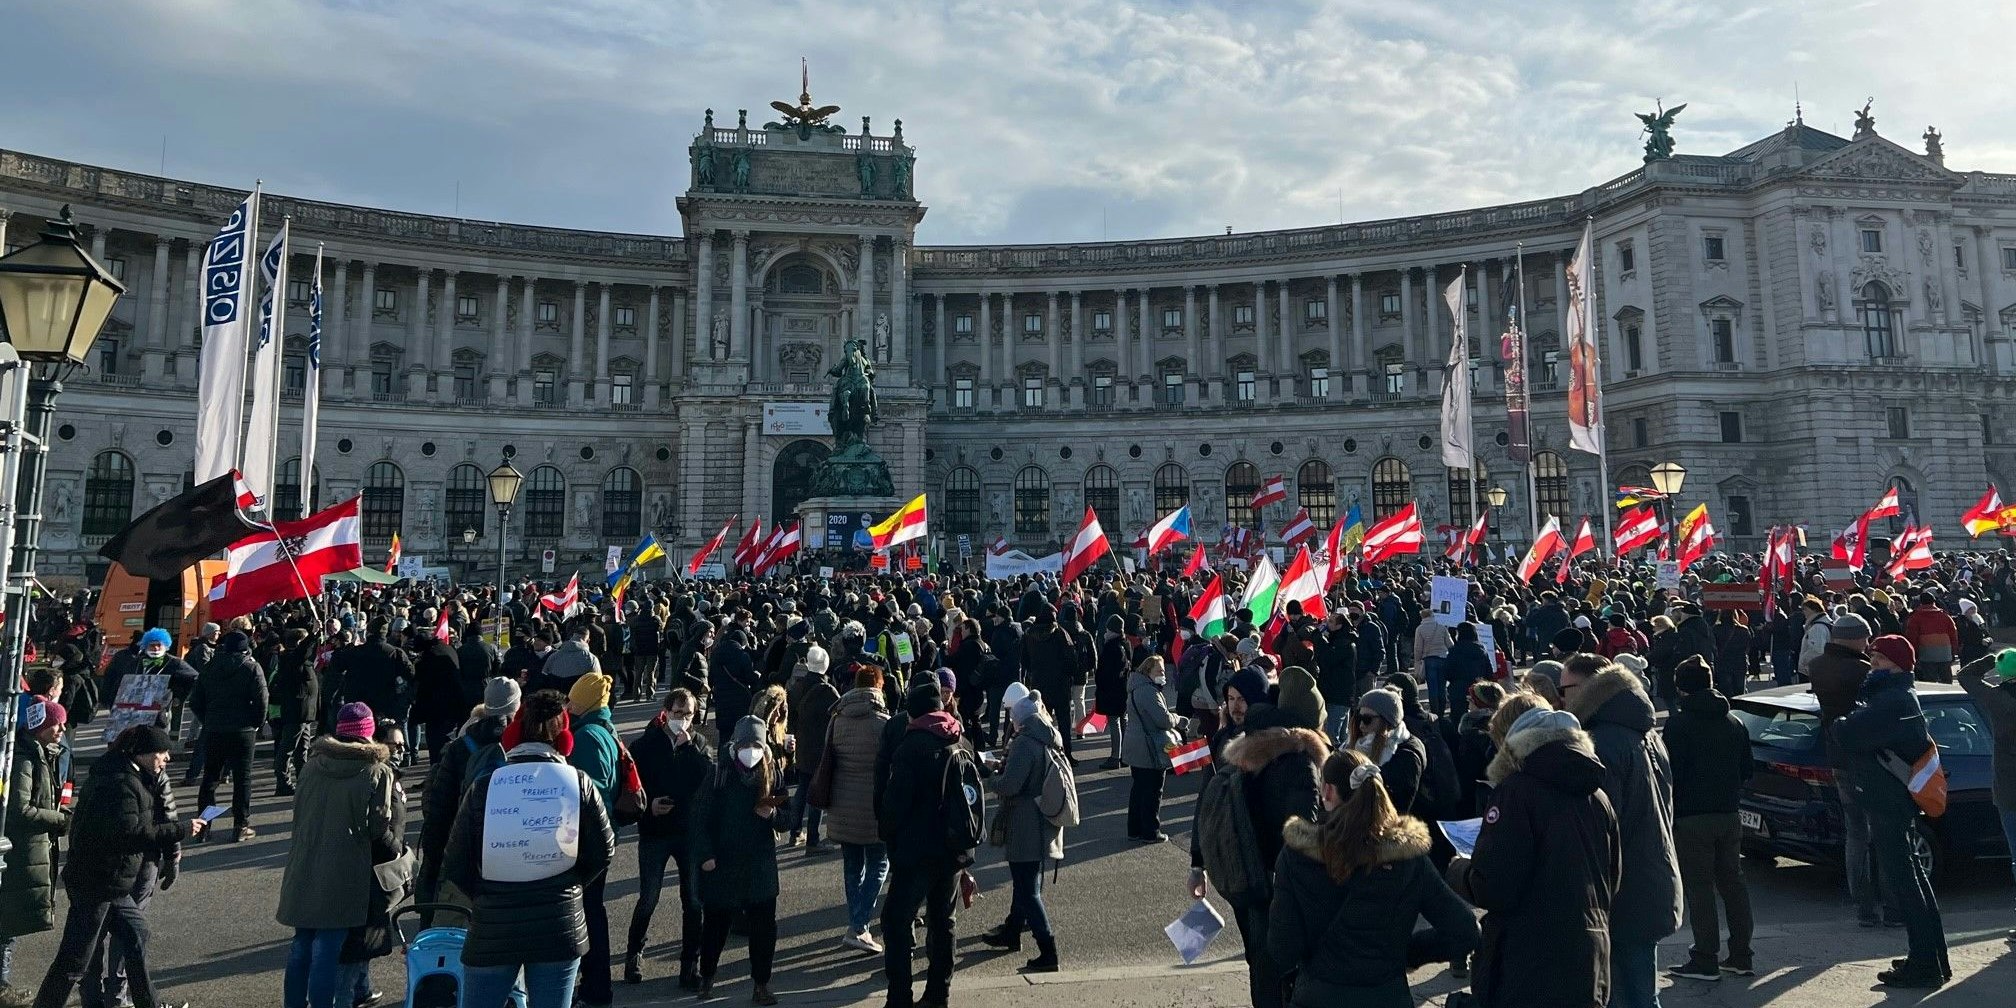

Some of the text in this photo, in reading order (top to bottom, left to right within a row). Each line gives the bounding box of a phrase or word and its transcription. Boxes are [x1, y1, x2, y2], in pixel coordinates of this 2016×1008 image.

[829, 515, 847, 524] 2020
[493, 774, 535, 785] UNSERE
[490, 807, 520, 815] UNSER
[491, 839, 530, 848] UNSERE
